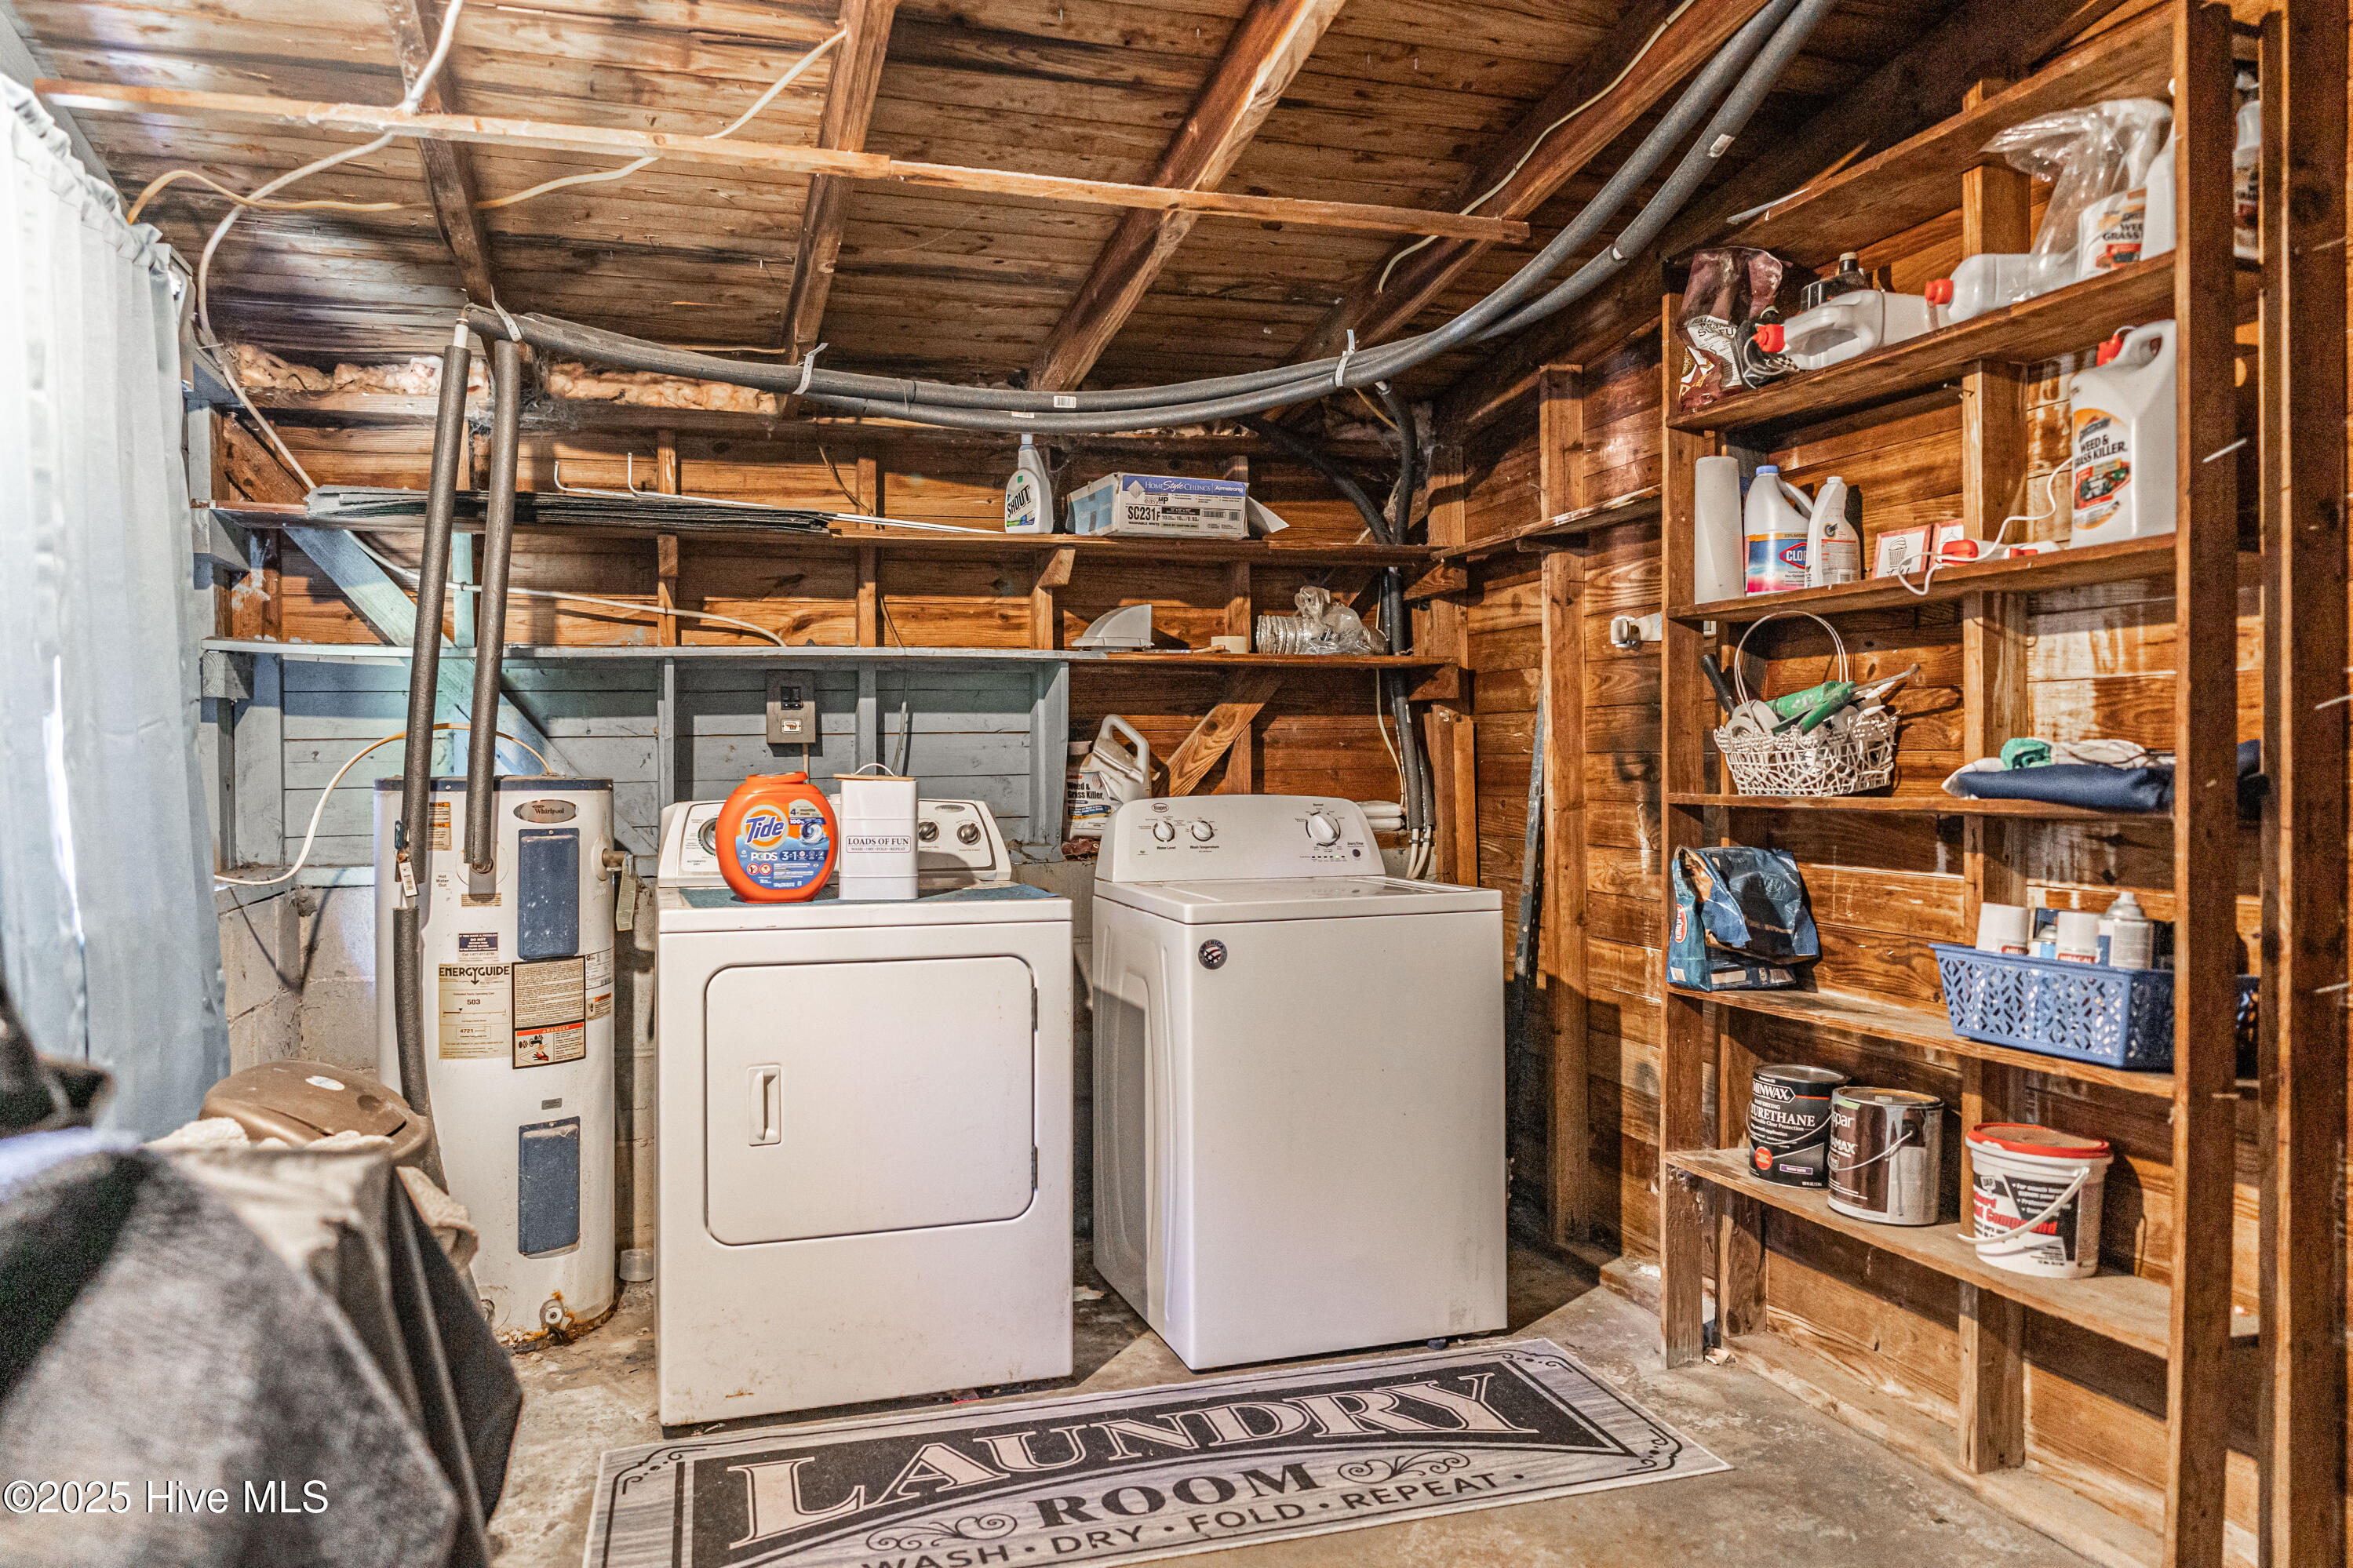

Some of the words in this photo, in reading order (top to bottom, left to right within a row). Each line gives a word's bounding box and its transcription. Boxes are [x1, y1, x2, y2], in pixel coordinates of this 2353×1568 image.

[2080, 437, 2100, 453] WEED
[2102, 434, 2109, 446] &
[2093, 441, 2125, 460] KILLER
[1214, 485, 1244, 493] Armstrong
[1007, 484, 1031, 518] SHOUT
[1127, 505, 1160, 522] SC231F
[1086, 791, 1103, 799] Killer
[745, 816, 785, 844] Tide
[439, 966, 510, 977] ENERGYGUIDE
[1753, 1081, 1789, 1101] MINWAX
[727, 1372, 1538, 1552] LAUNDRY
[1032, 1461, 1325, 1529] ROOM
[1051, 1524, 1144, 1555] DRY
[1186, 1503, 1306, 1533] FOLD
[1340, 1472, 1499, 1510] REPEAT
